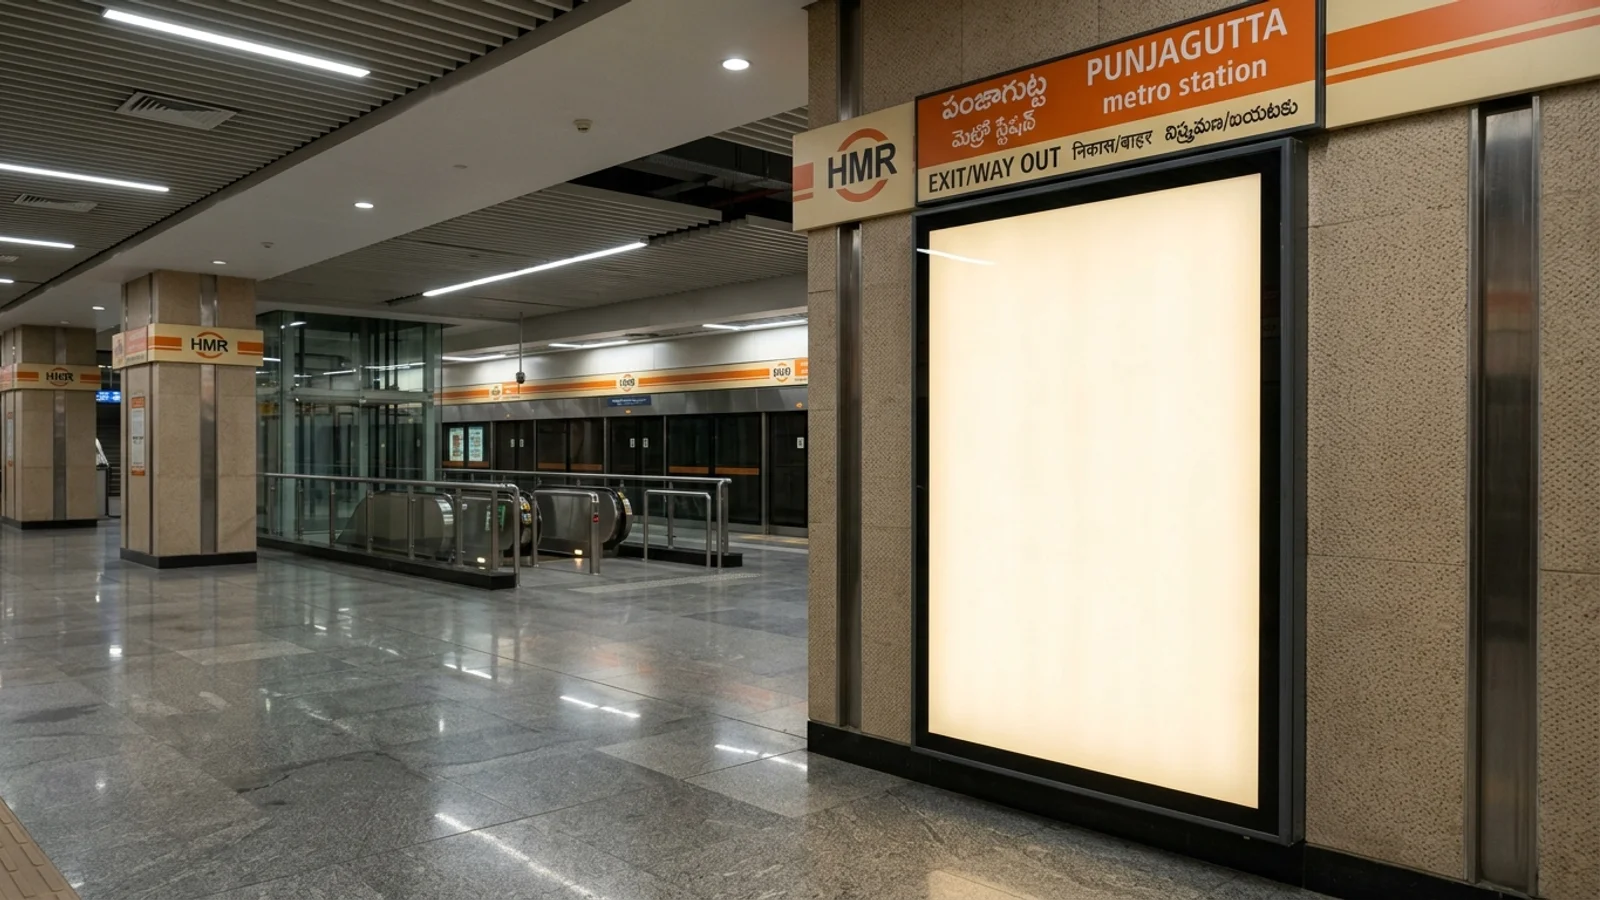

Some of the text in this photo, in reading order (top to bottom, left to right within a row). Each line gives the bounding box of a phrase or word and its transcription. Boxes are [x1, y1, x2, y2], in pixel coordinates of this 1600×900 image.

[1087, 8, 1288, 86] PUNJAGUTTA
[1103, 58, 1267, 114] metro station
[827, 143, 898, 189] HMR
[928, 146, 1061, 193] EXIT/WAY OUT
[191, 338, 229, 352] HMR
